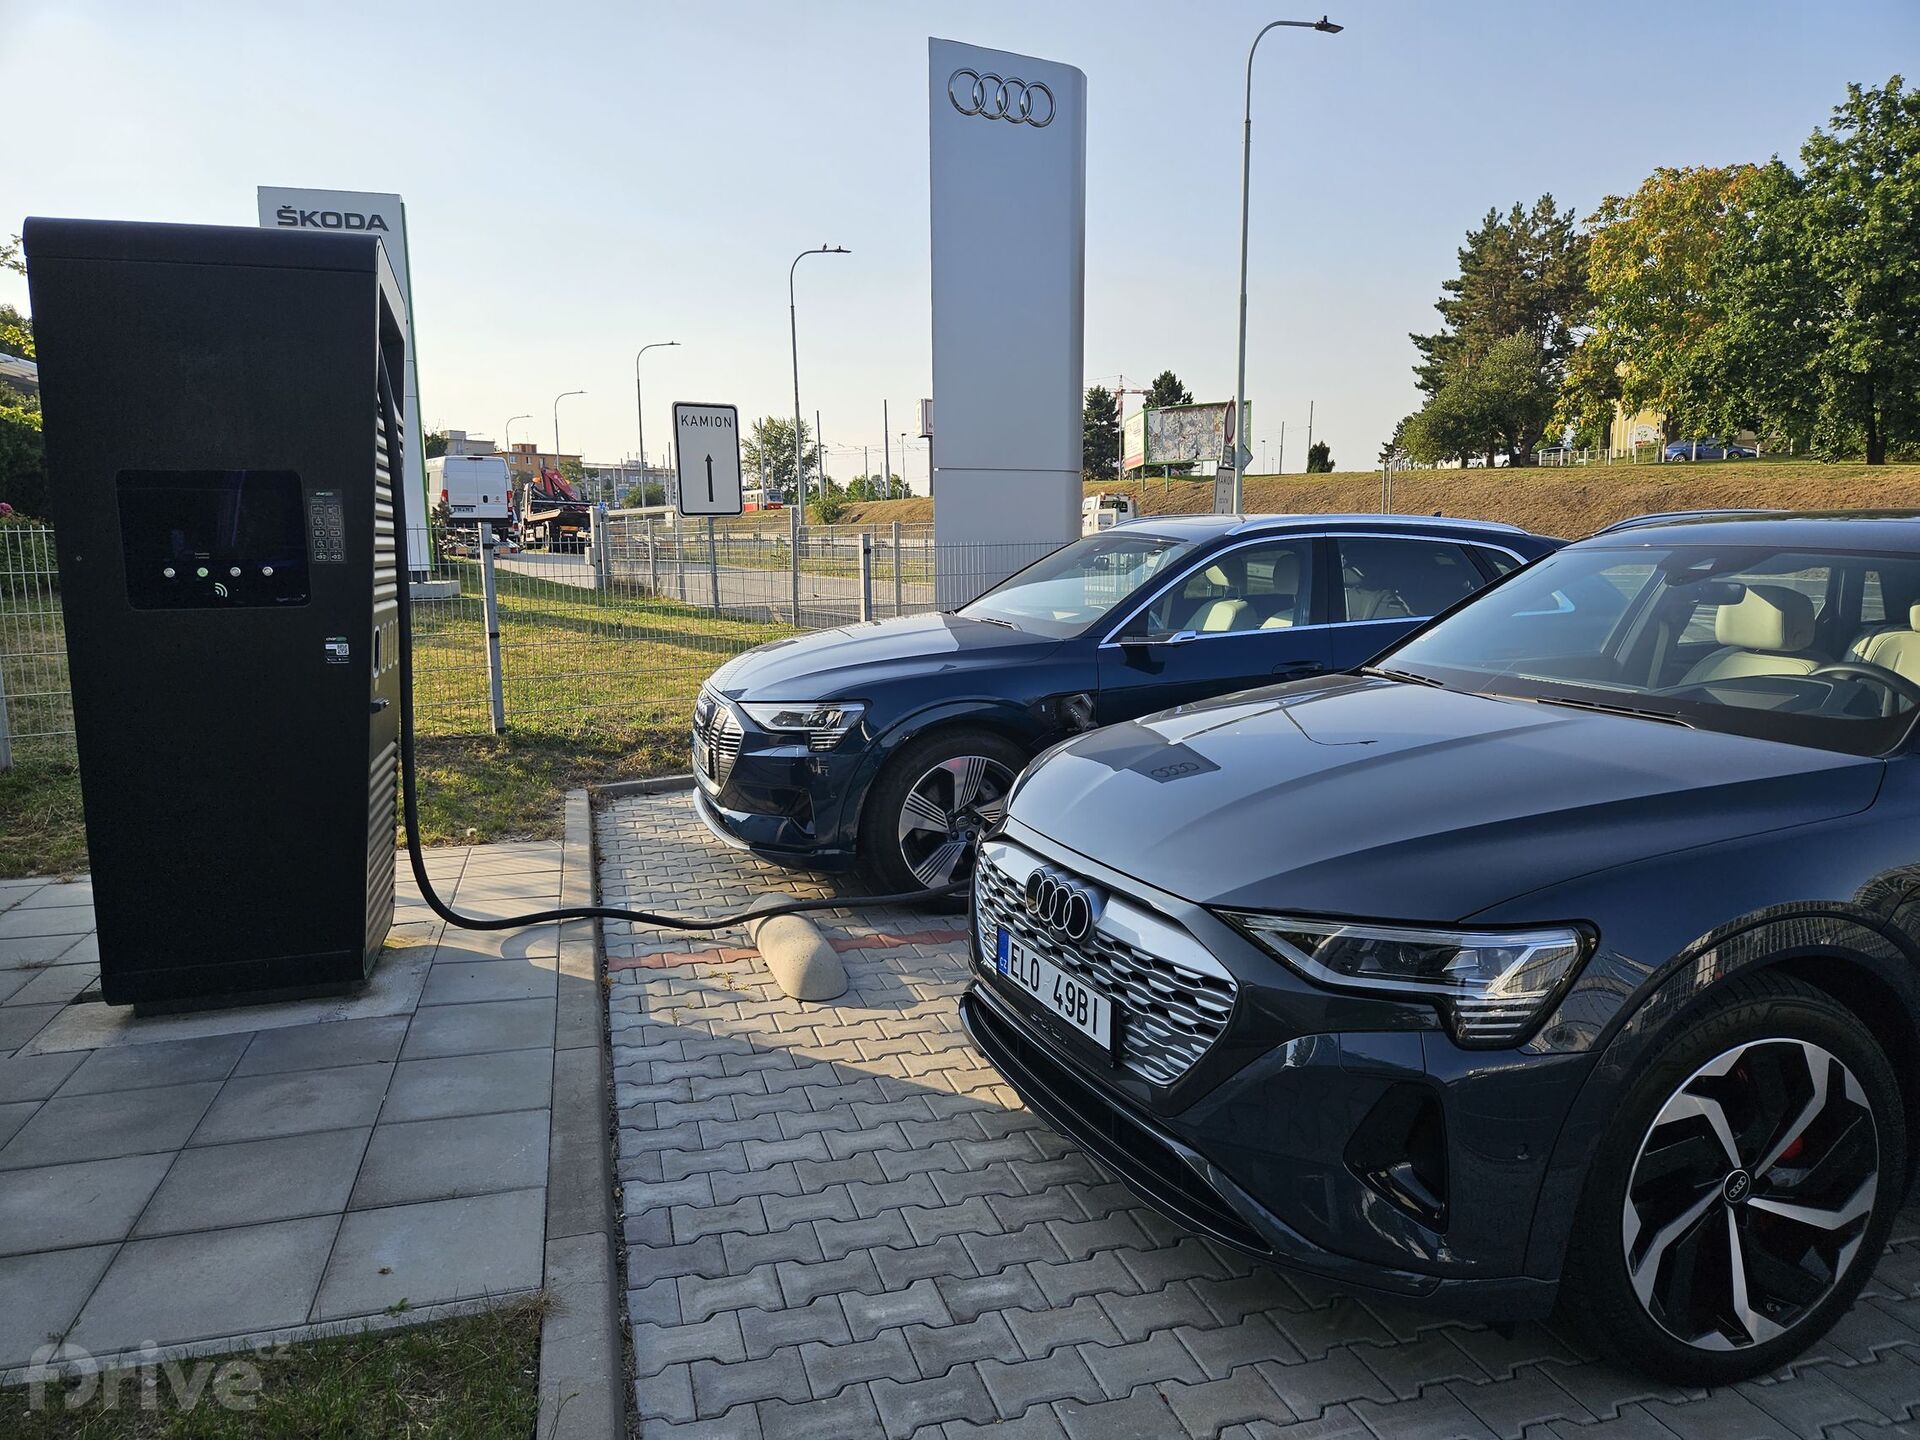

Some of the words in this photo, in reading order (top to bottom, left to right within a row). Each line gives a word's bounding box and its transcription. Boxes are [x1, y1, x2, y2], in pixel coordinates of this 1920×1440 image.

[277, 205, 389, 232] ŠKODA
[681, 414, 731, 428] KAMION
[1000, 956, 1008, 970] CZ
